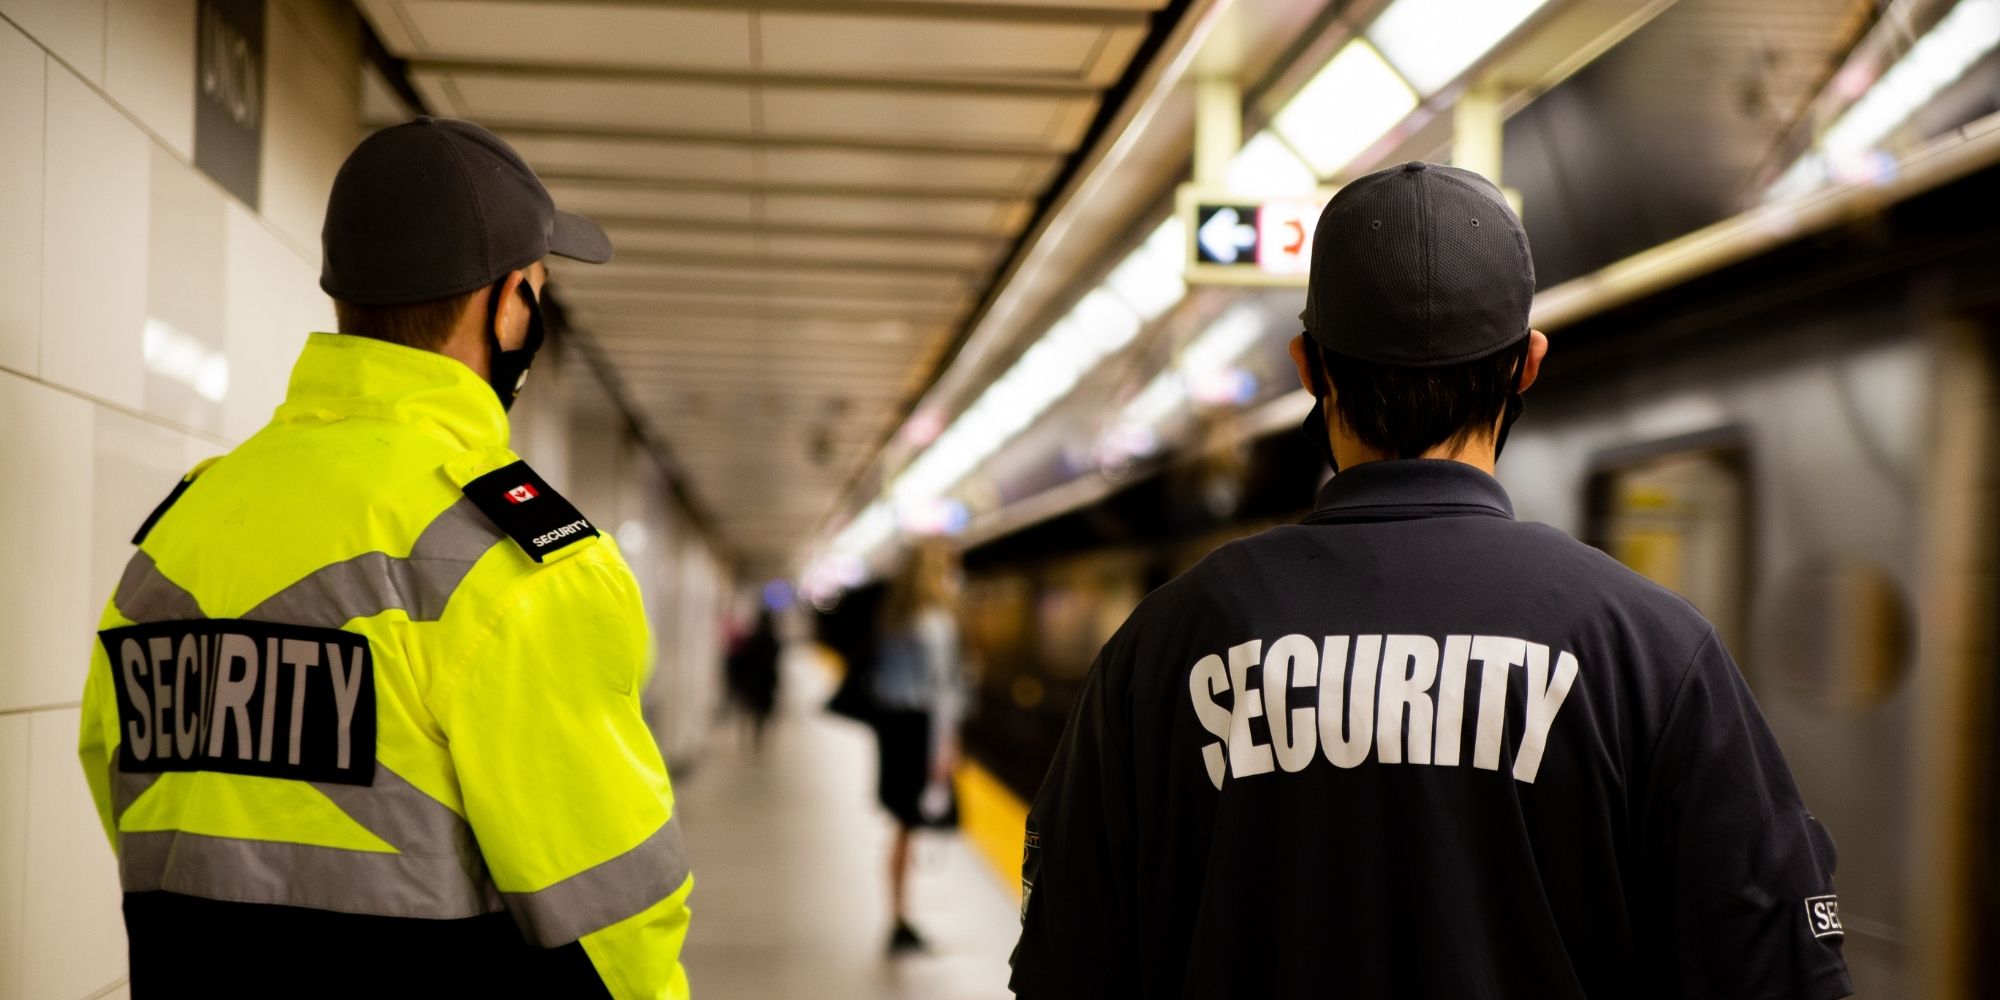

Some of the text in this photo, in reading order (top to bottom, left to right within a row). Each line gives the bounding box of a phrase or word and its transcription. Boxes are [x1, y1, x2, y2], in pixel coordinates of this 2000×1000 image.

[532, 519, 589, 547] SECURITY
[120, 633, 364, 770] SECURITY
[1189, 633, 1579, 792] SECURITY
